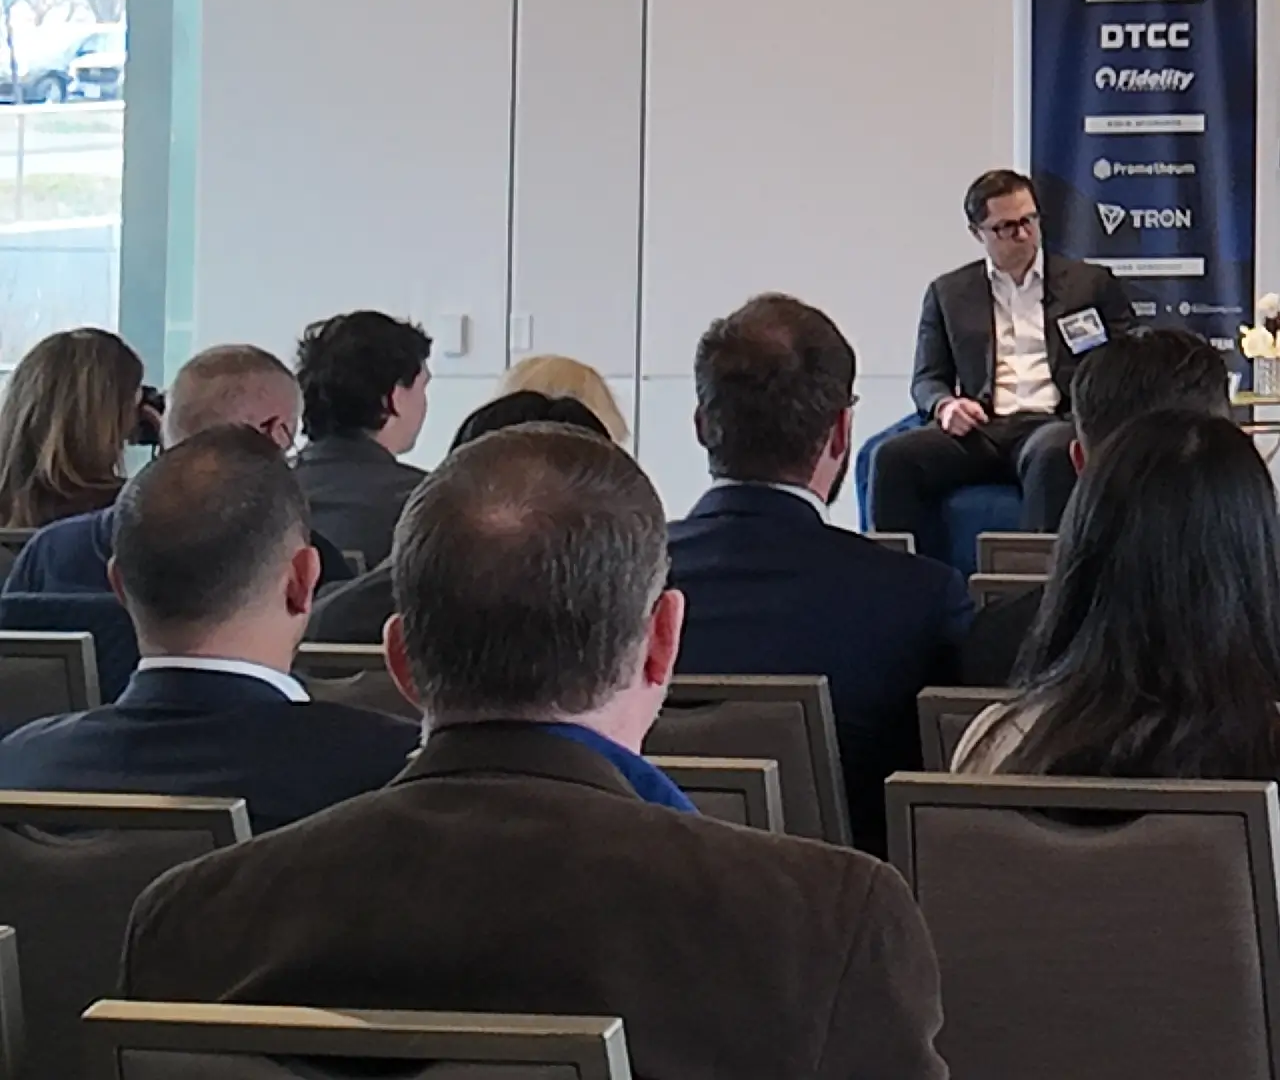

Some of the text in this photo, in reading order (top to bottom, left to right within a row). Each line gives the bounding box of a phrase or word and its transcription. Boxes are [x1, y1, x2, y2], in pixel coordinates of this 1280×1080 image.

[1101, 23, 1189, 48] DTCC
[1117, 68, 1195, 91] Fidelity
[1130, 208, 1191, 229] TRON
